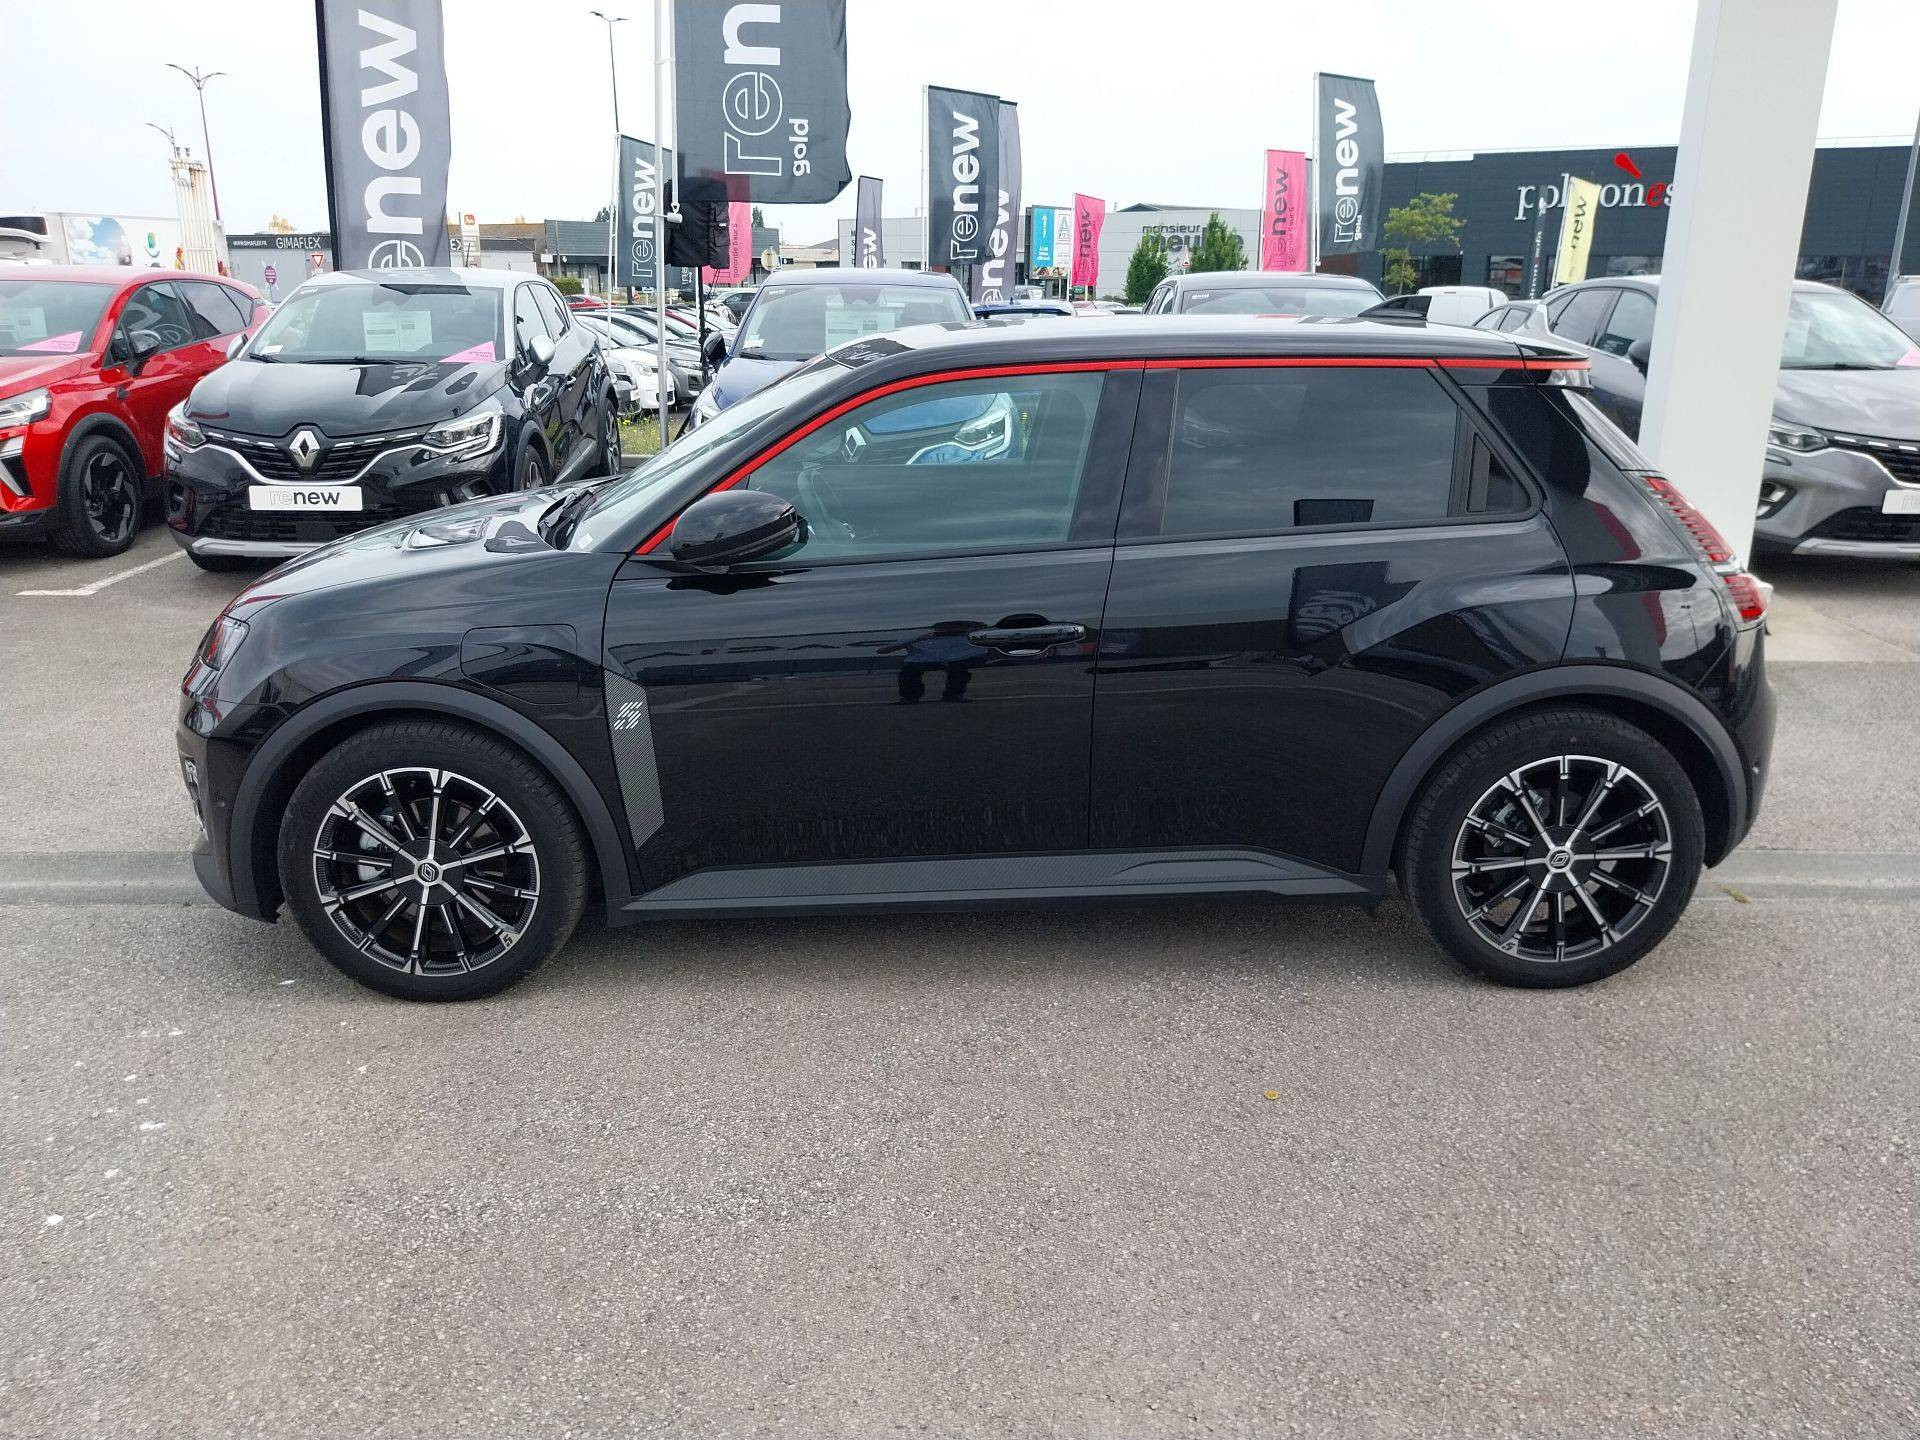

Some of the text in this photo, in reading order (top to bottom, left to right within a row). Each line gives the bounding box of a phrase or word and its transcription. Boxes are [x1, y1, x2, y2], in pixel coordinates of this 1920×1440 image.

[788, 118, 811, 177] gold
[951, 110, 980, 261] renew
[1334, 98, 1359, 243] renew
[276, 237, 321, 249] GIMAFLEX
[632, 157, 656, 278] renew
[1142, 223, 1202, 234] monsieur
[1270, 166, 1289, 268] renew
[269, 490, 341, 505] renew
